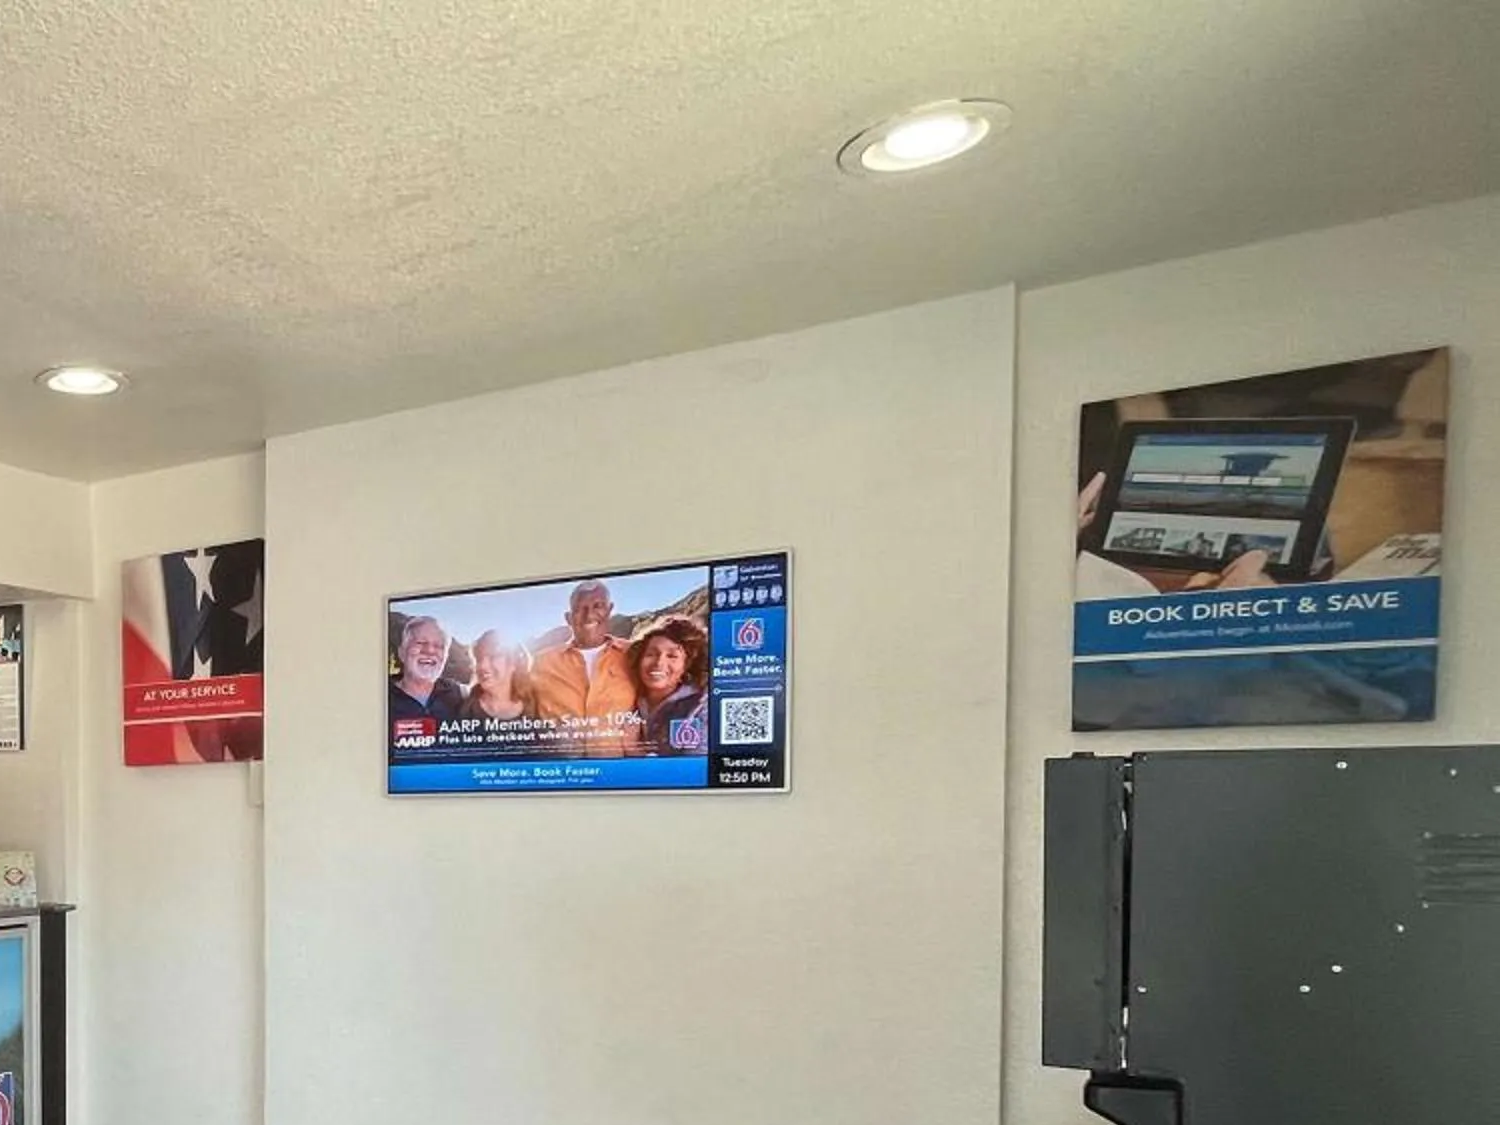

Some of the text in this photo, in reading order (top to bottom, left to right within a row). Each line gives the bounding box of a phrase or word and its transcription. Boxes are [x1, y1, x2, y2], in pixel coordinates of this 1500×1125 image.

[1108, 591, 1400, 626] BOOK DIRECT & SAVE
[716, 653, 780, 666] Save More.
[713, 664, 783, 677] Book Faster.
[143, 683, 237, 701] AT YOUR SERVICE
[438, 718, 481, 733] AARP
[485, 715, 557, 732] Members
[560, 713, 600, 727] Save
[606, 709, 647, 725] 10%.
[394, 735, 436, 748] AARP
[438, 727, 629, 744] Plus late checkout when available.
[721, 757, 769, 768] Tuesday
[472, 765, 603, 779] Save More. Book Faster.
[719, 771, 771, 783] 12:50 PM
